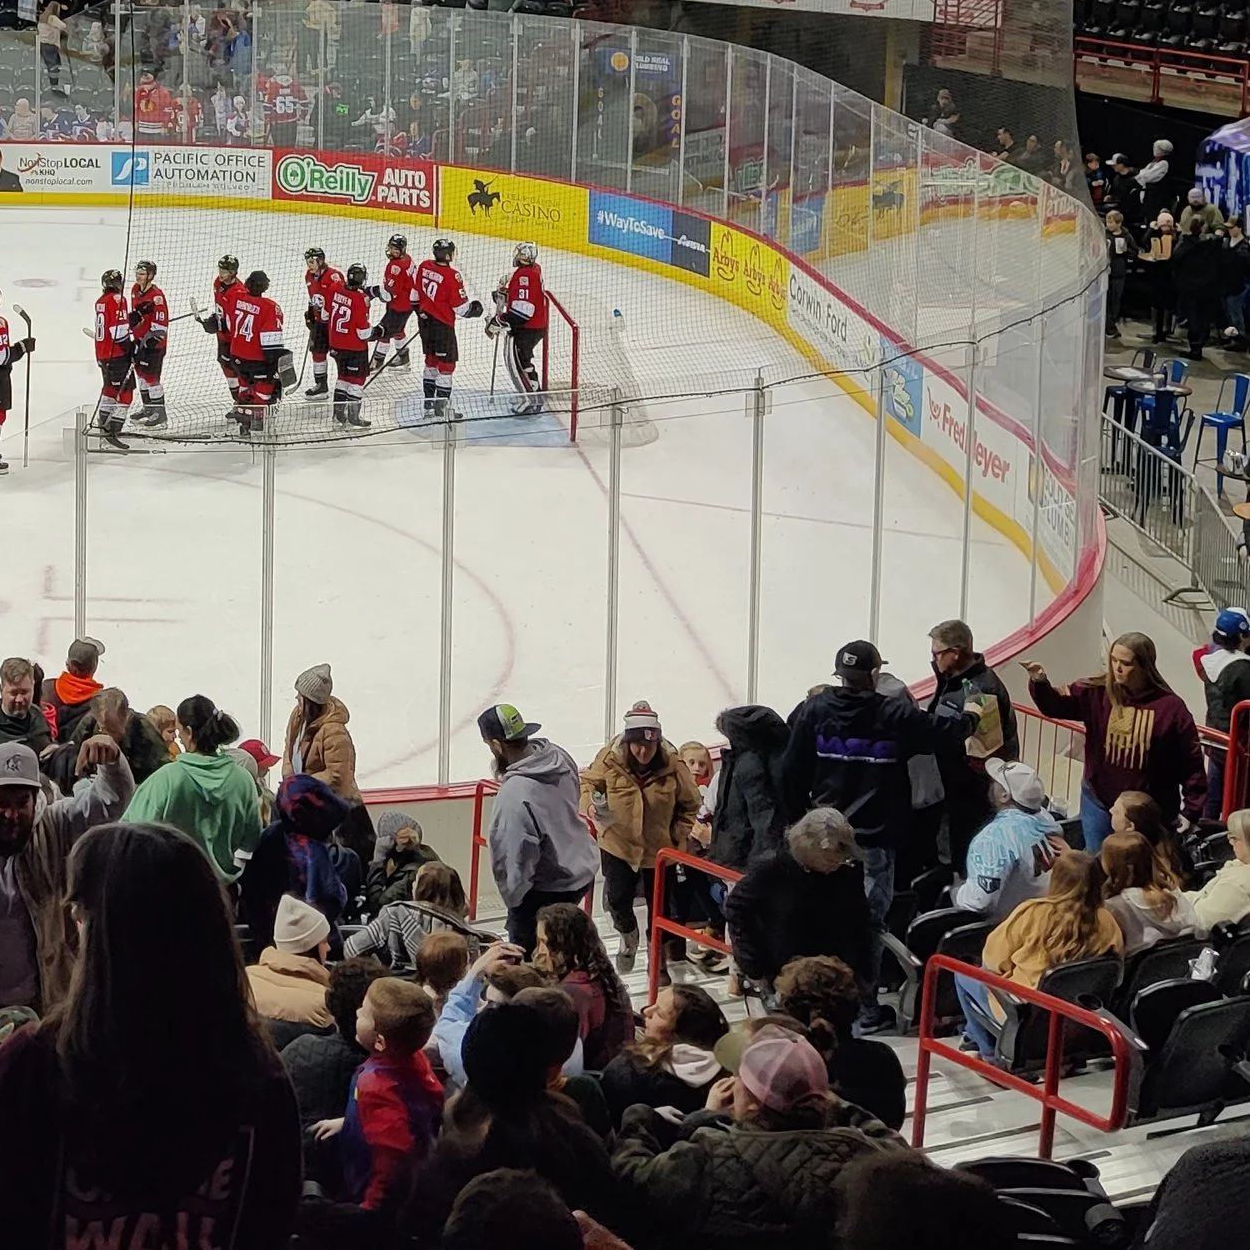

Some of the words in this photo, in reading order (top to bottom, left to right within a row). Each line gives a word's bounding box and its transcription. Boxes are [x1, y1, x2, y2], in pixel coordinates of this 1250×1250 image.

[276, 96, 294, 114] 65
[671, 94, 681, 148] GOAL
[154, 153, 209, 166] PACIFIC
[215, 154, 266, 168] OFFICE
[25, 177, 93, 186] nonstoplocal.com
[153, 168, 256, 183] AUTOMATION
[281, 156, 373, 198] O'Reilly
[382, 168, 426, 189] AUTO
[377, 185, 431, 208] PARTS
[501, 200, 561, 222] CASINO
[597, 209, 665, 240] #WayToSave
[518, 288, 529, 300] 31
[331, 301, 352, 334] 72
[789, 273, 822, 322] Corwin
[826, 304, 848, 343] Ford
[234, 309, 255, 342] 74
[942, 402, 967, 455] Fred
